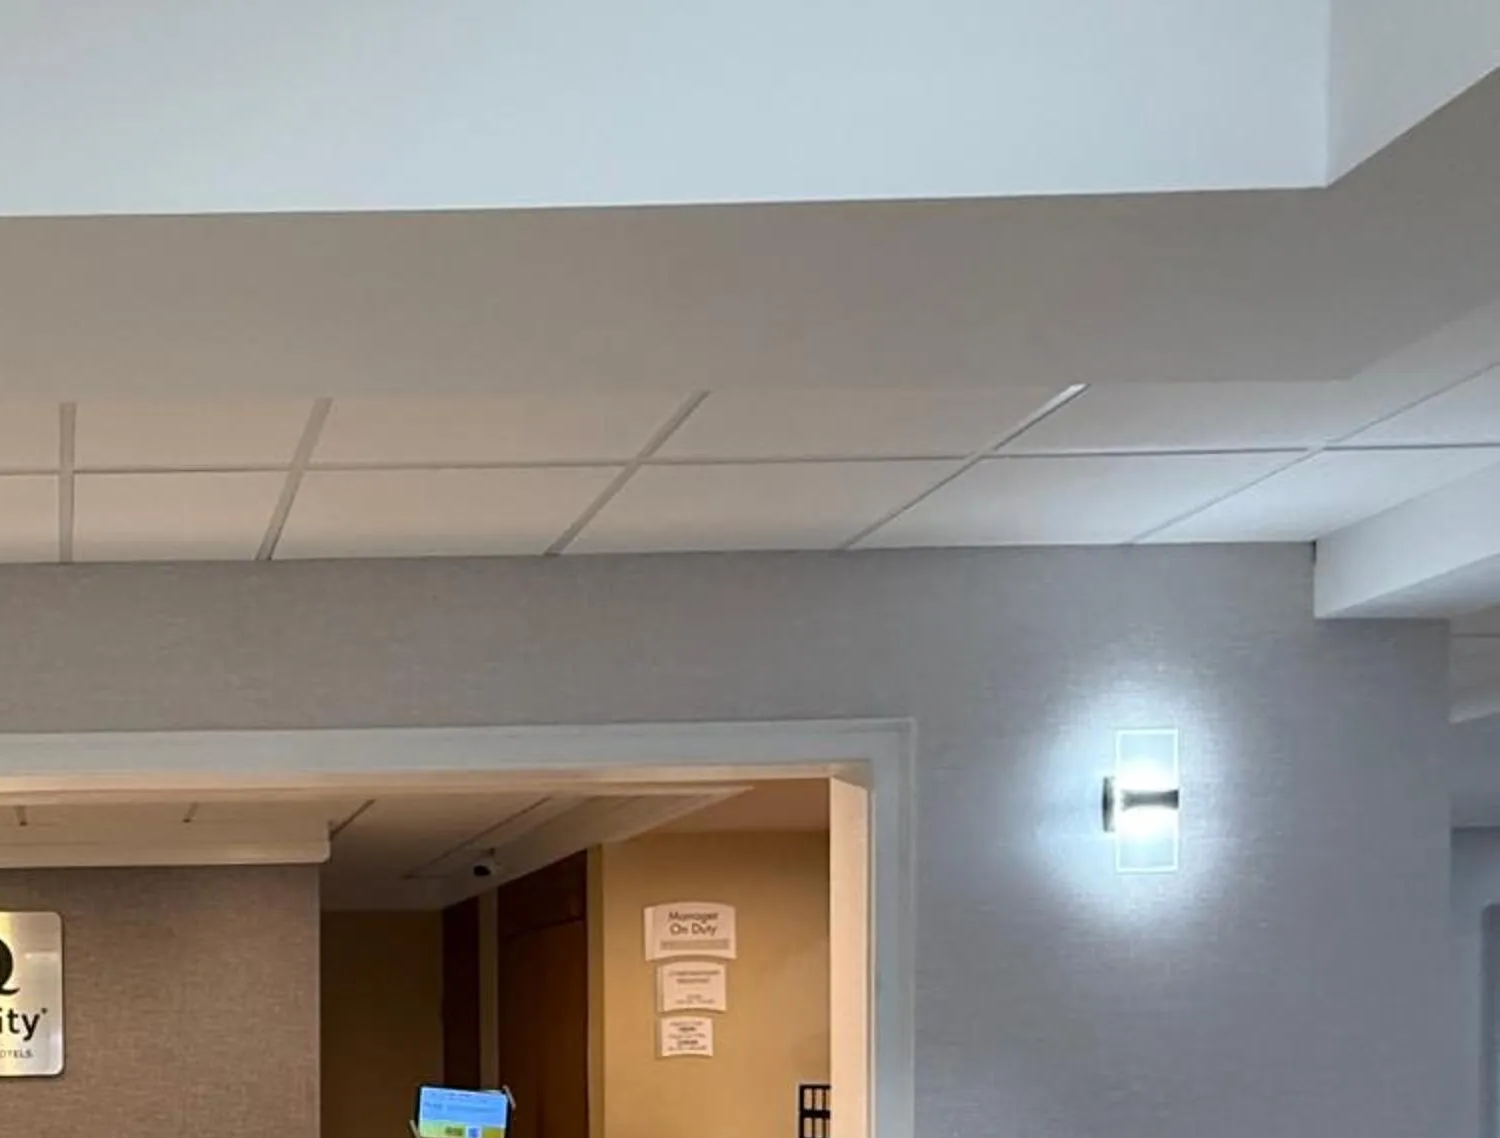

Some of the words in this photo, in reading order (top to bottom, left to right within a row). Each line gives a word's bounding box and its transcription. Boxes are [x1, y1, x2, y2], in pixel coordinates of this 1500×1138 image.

[668, 911, 718, 924] Manager
[669, 922, 688, 935] On
[691, 922, 718, 936] Duty
